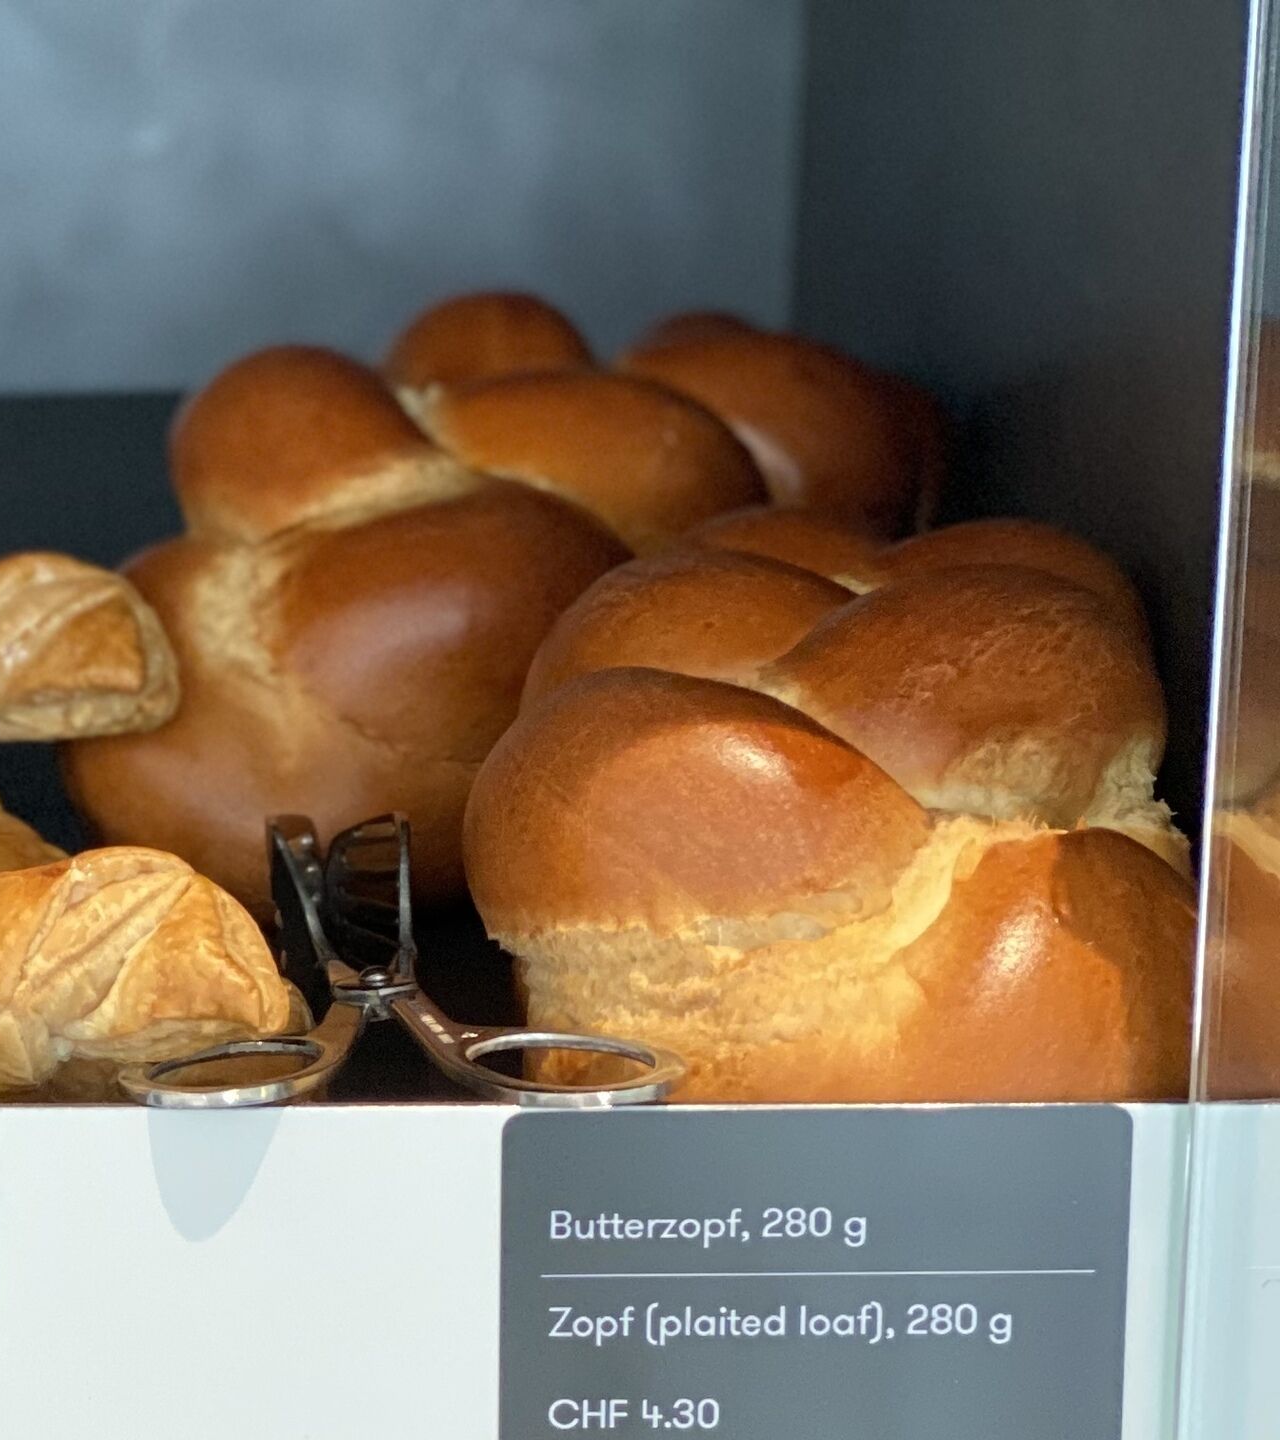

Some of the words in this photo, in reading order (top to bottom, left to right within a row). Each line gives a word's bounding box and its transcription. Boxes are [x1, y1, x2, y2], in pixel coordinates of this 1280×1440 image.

[550, 1206, 750, 1249] Butterzopf,
[761, 1206, 833, 1238] 280
[843, 1216, 867, 1248] g
[548, 1305, 635, 1347] Zopf
[645, 1302, 786, 1347] (plaited
[799, 1300, 895, 1345] loaf),
[906, 1303, 978, 1335] 280
[988, 1312, 1013, 1345] g
[547, 1398, 629, 1430] CHF
[641, 1398, 720, 1430] 4.30
